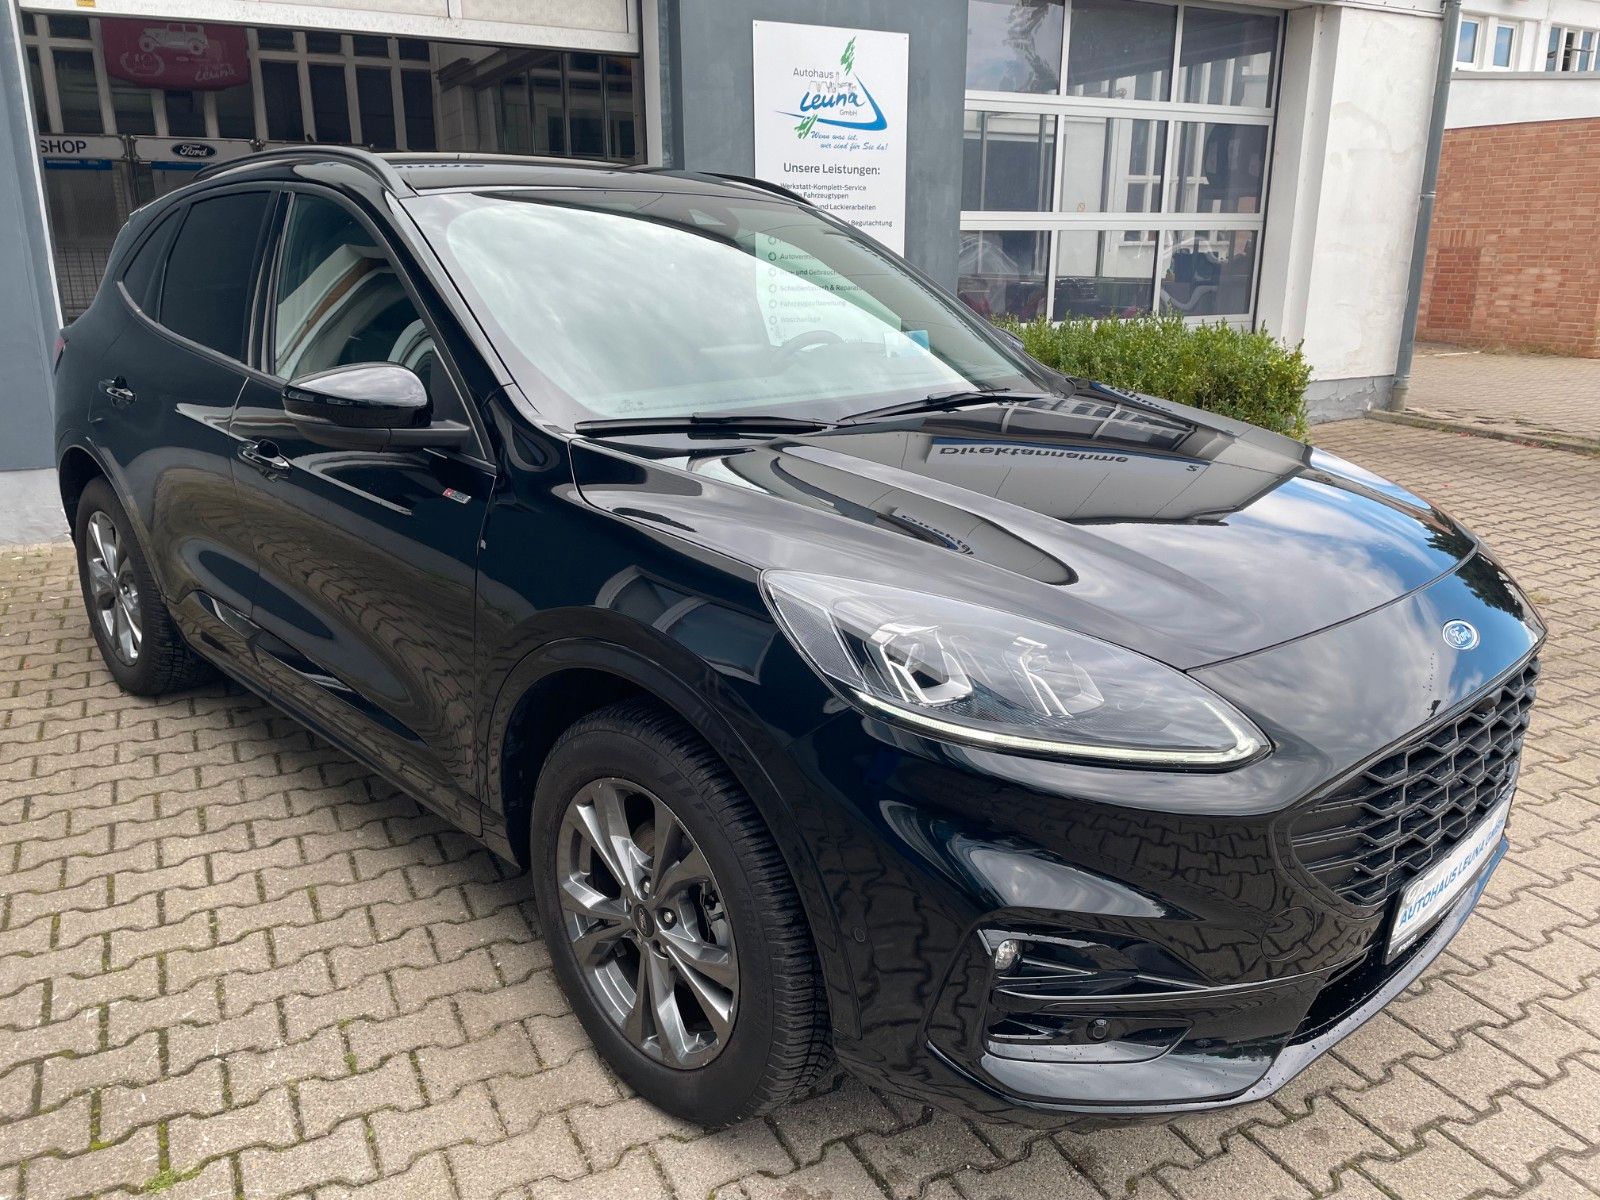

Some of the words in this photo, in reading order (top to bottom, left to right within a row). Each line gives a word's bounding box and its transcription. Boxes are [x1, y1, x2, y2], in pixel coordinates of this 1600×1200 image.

[793, 67, 834, 79] Autohaus
[811, 131, 830, 139] Wenn
[863, 142, 874, 150] Sie
[783, 163, 820, 174] Unsere
[822, 164, 881, 177] Leistungen:
[803, 192, 849, 200] Fahrzeugtypen
[830, 204, 876, 212] Lackierarbeiten
[1399, 872, 1461, 928] AUTOHAUS
